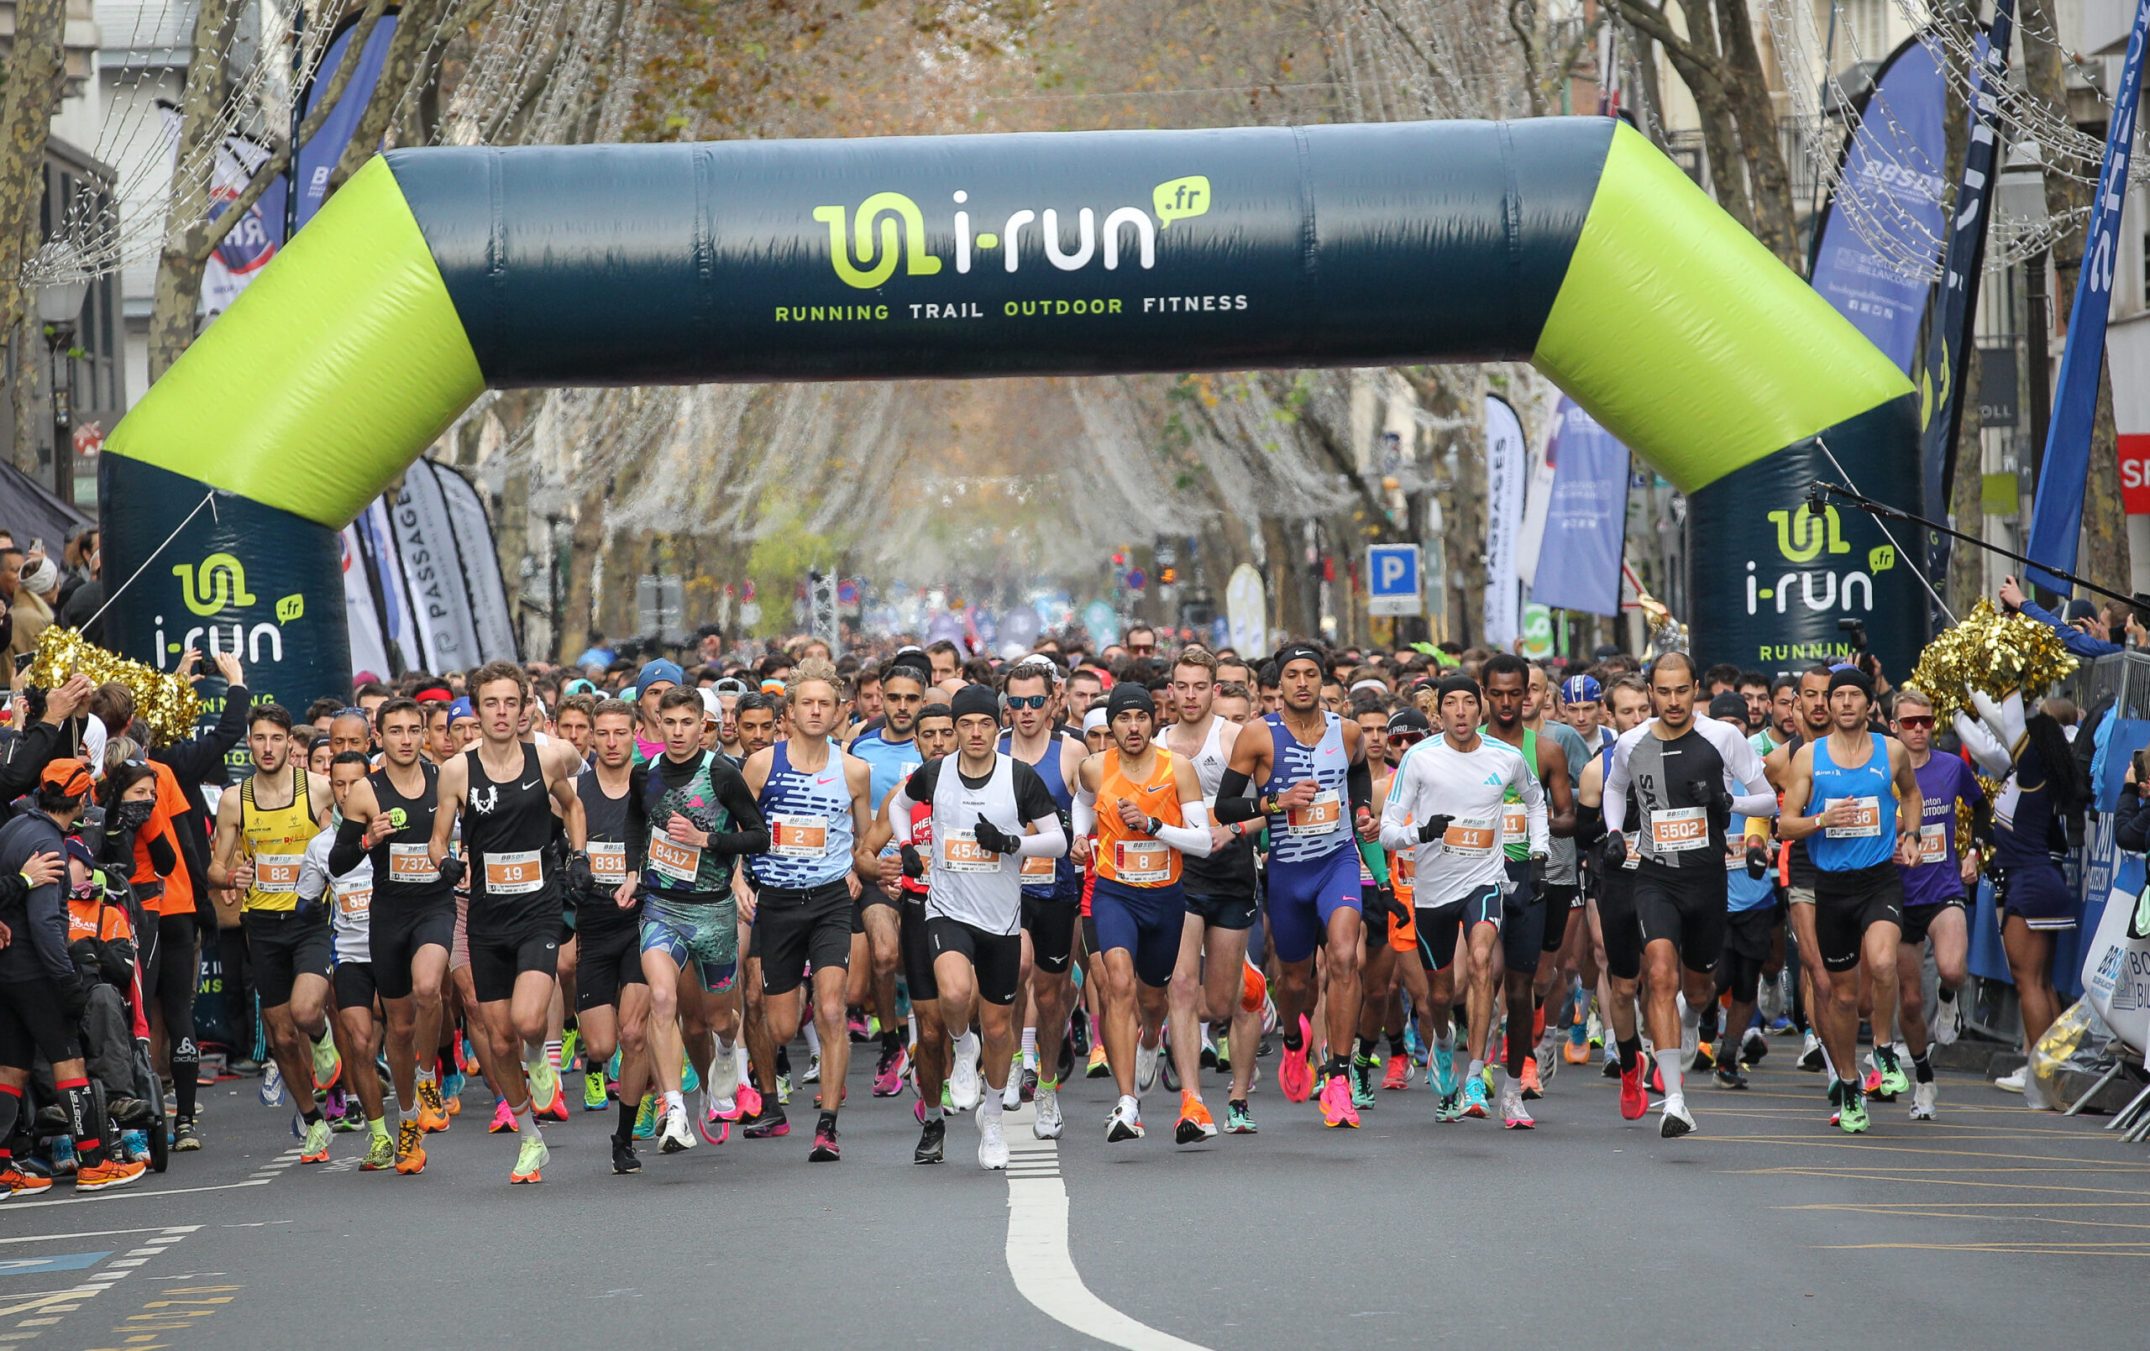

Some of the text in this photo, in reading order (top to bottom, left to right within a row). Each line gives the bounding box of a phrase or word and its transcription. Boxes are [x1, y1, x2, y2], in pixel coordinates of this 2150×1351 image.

[952, 185, 1201, 275] i-run .fr
[775, 295, 1249, 322] RUNNING TRAIL OUTDOOR FITNESS
[1382, 555, 1405, 590] P
[1746, 552, 1890, 616] i-run .fr
[155, 601, 298, 669] i-run .fr
[1760, 642, 1857, 661] RUNNIN
[1305, 807, 1325, 821] 78
[794, 830, 804, 844] 2
[1461, 830, 1479, 845] 11
[1659, 822, 1699, 840] 5502
[595, 856, 626, 872] 831
[655, 843, 690, 867] 8417
[1139, 855, 1149, 869] 8
[271, 867, 290, 881] 82
[503, 866, 524, 881] 19
